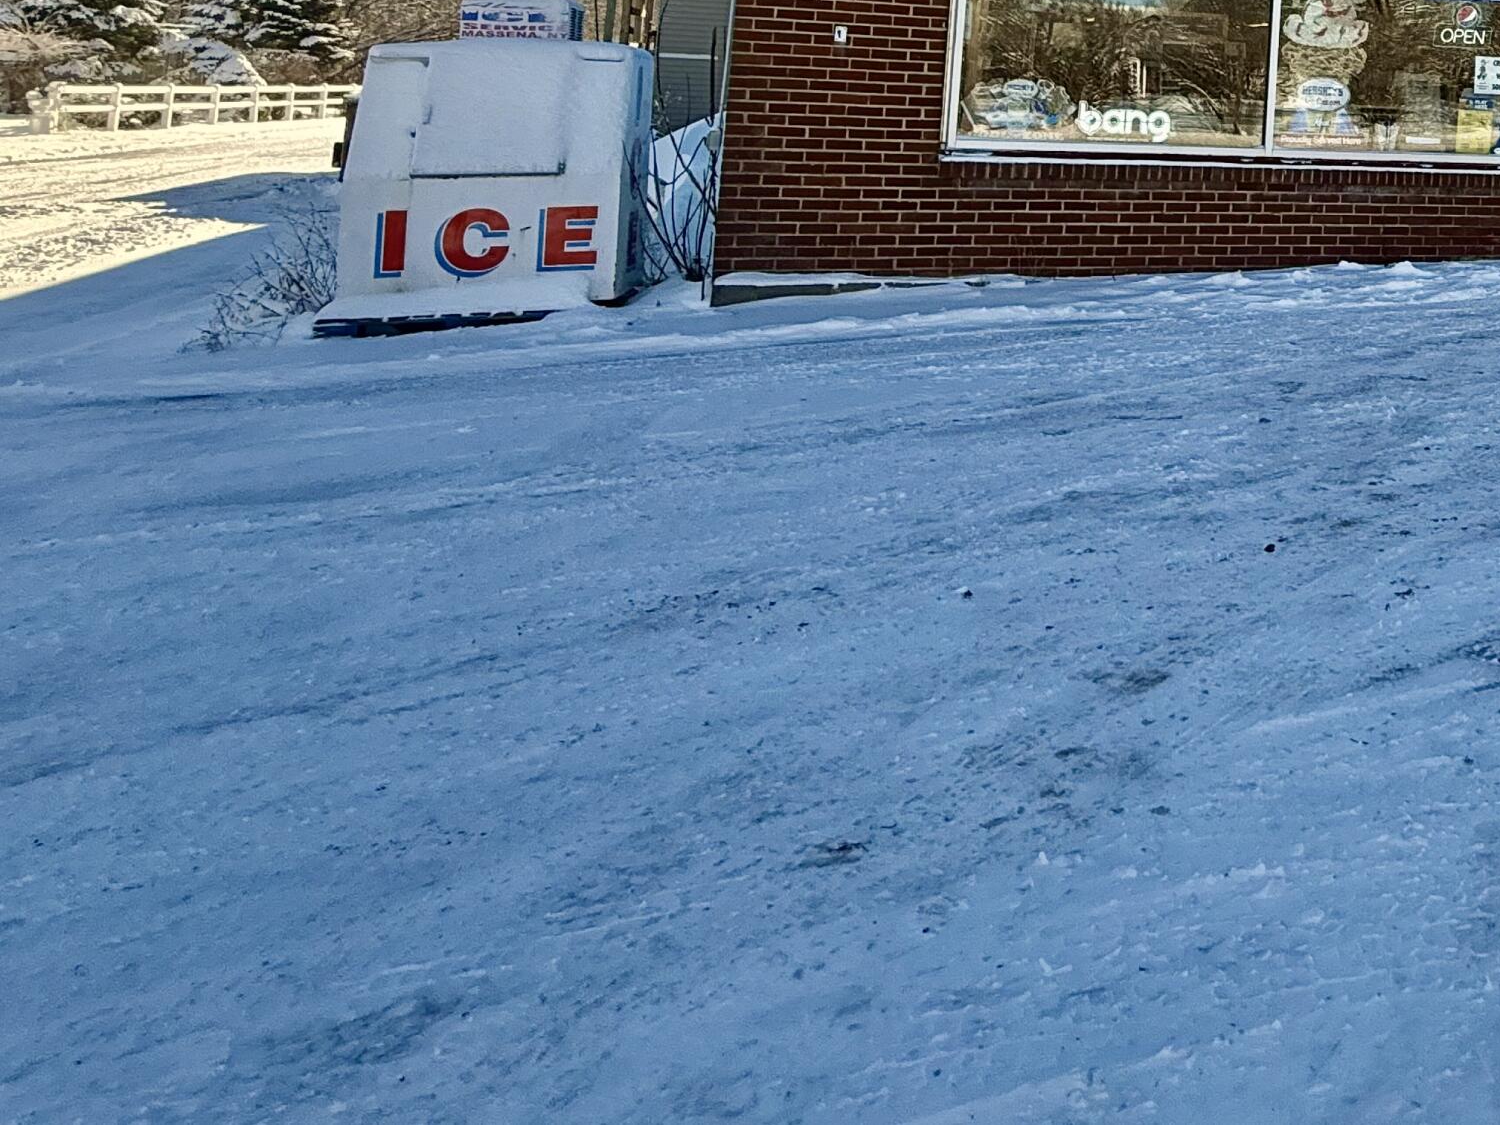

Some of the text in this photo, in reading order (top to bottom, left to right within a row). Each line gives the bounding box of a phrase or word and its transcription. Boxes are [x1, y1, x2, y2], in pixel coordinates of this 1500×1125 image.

[463, 22, 568, 32] SERVICE
[1440, 28, 1486, 45] OPEN
[1075, 100, 1171, 143] bang
[373, 205, 599, 279] ICE
